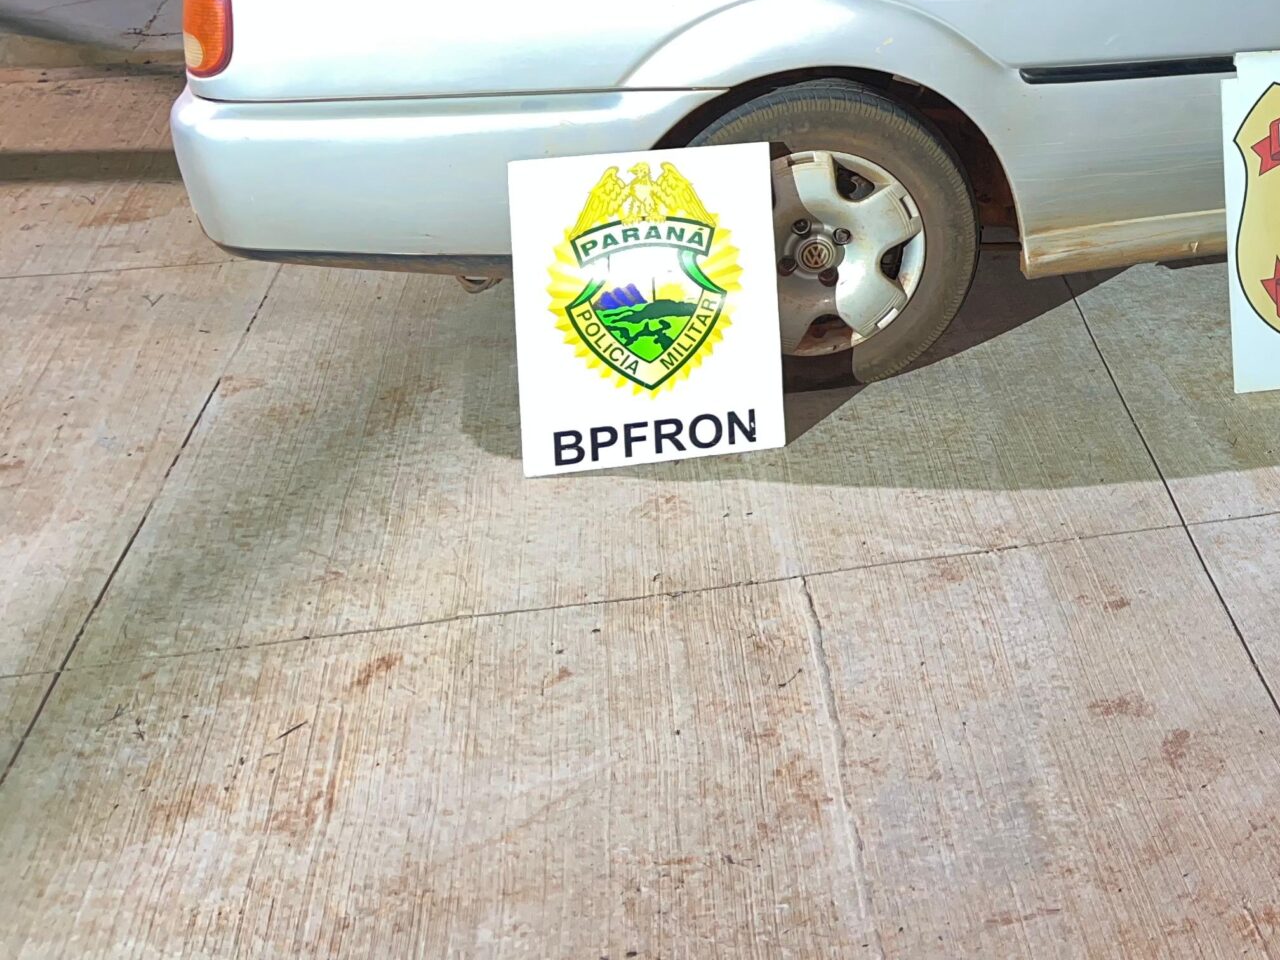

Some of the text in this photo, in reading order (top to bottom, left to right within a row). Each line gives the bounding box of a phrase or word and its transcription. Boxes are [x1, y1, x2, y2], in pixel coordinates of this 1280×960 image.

[581, 226, 705, 257] PARANÁ
[577, 299, 717, 375] POLÍCIA MILITAR
[553, 408, 757, 466] BPFRON
